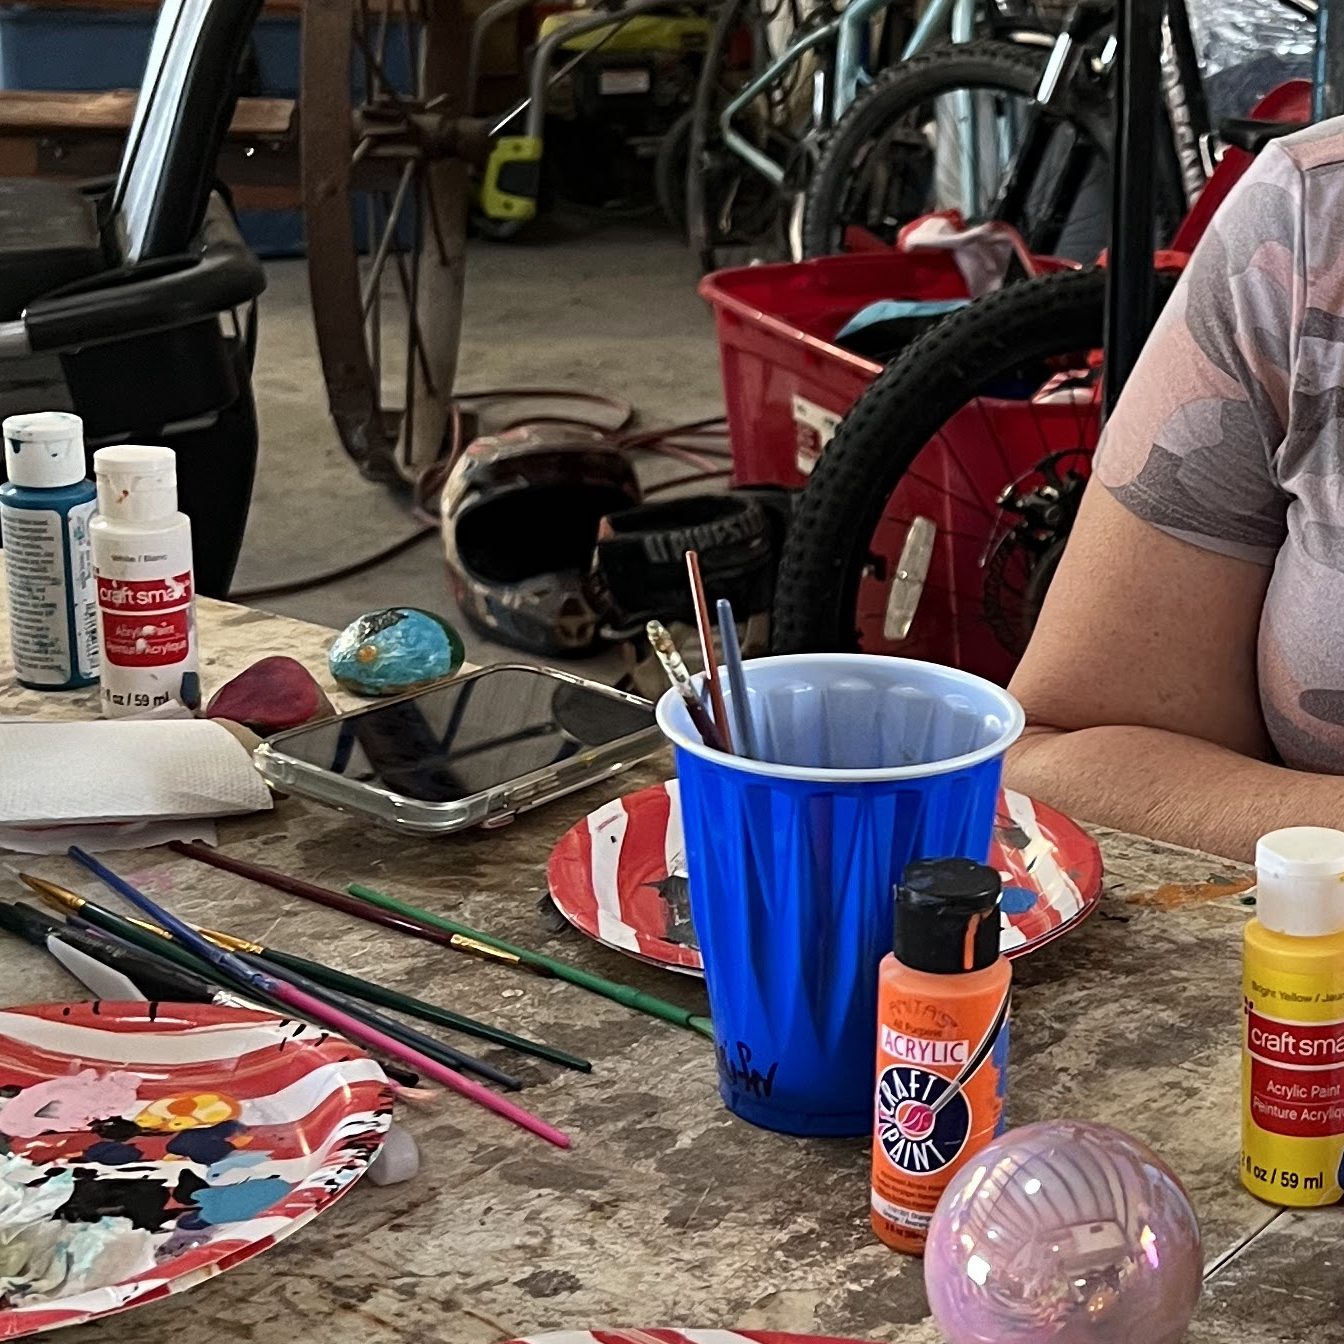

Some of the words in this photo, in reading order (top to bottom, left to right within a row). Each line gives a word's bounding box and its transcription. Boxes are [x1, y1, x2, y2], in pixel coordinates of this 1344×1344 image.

[134, 693, 149, 707] 59
[884, 1030, 965, 1063] ACRYLIC
[1251, 1027, 1297, 1055] craft
[879, 1069, 938, 1116] CRAFT
[1266, 1079, 1308, 1100] Acrylic
[1310, 1084, 1341, 1099] Paint
[1252, 1095, 1298, 1121] Peinture
[881, 1127, 946, 1171] PAINT
[1253, 1165, 1268, 1182] oz
[1280, 1171, 1299, 1189] 59
[1303, 1171, 1324, 1189] ml
